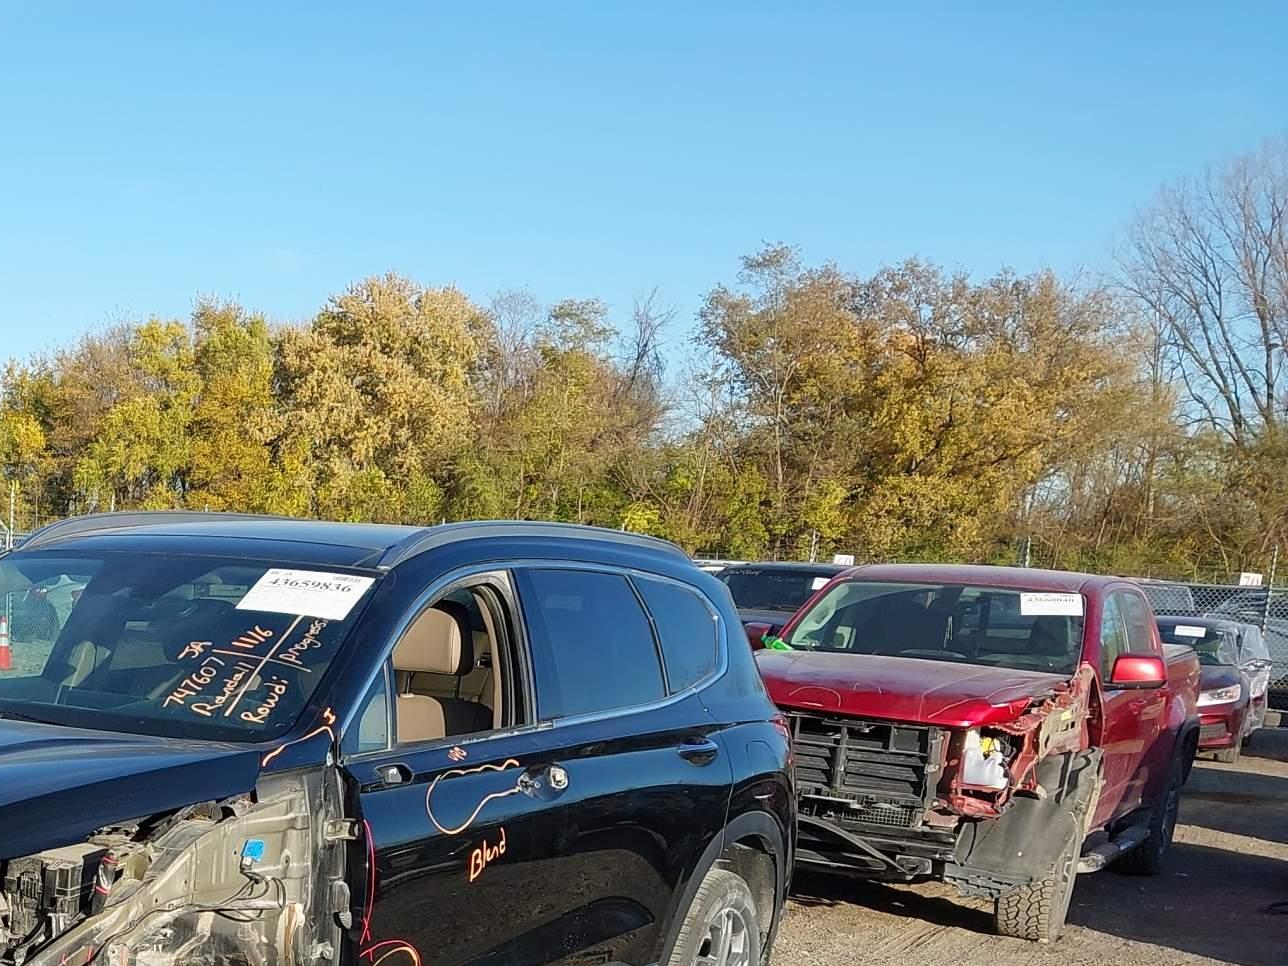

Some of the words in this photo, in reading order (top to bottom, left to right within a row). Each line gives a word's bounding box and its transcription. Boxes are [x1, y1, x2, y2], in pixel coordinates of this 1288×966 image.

[268, 578, 352, 593] 43659836
[231, 625, 273, 648] 11/6
[162, 656, 225, 708] 747607
[190, 662, 256, 717] Randall
[469, 827, 507, 883] Blend
